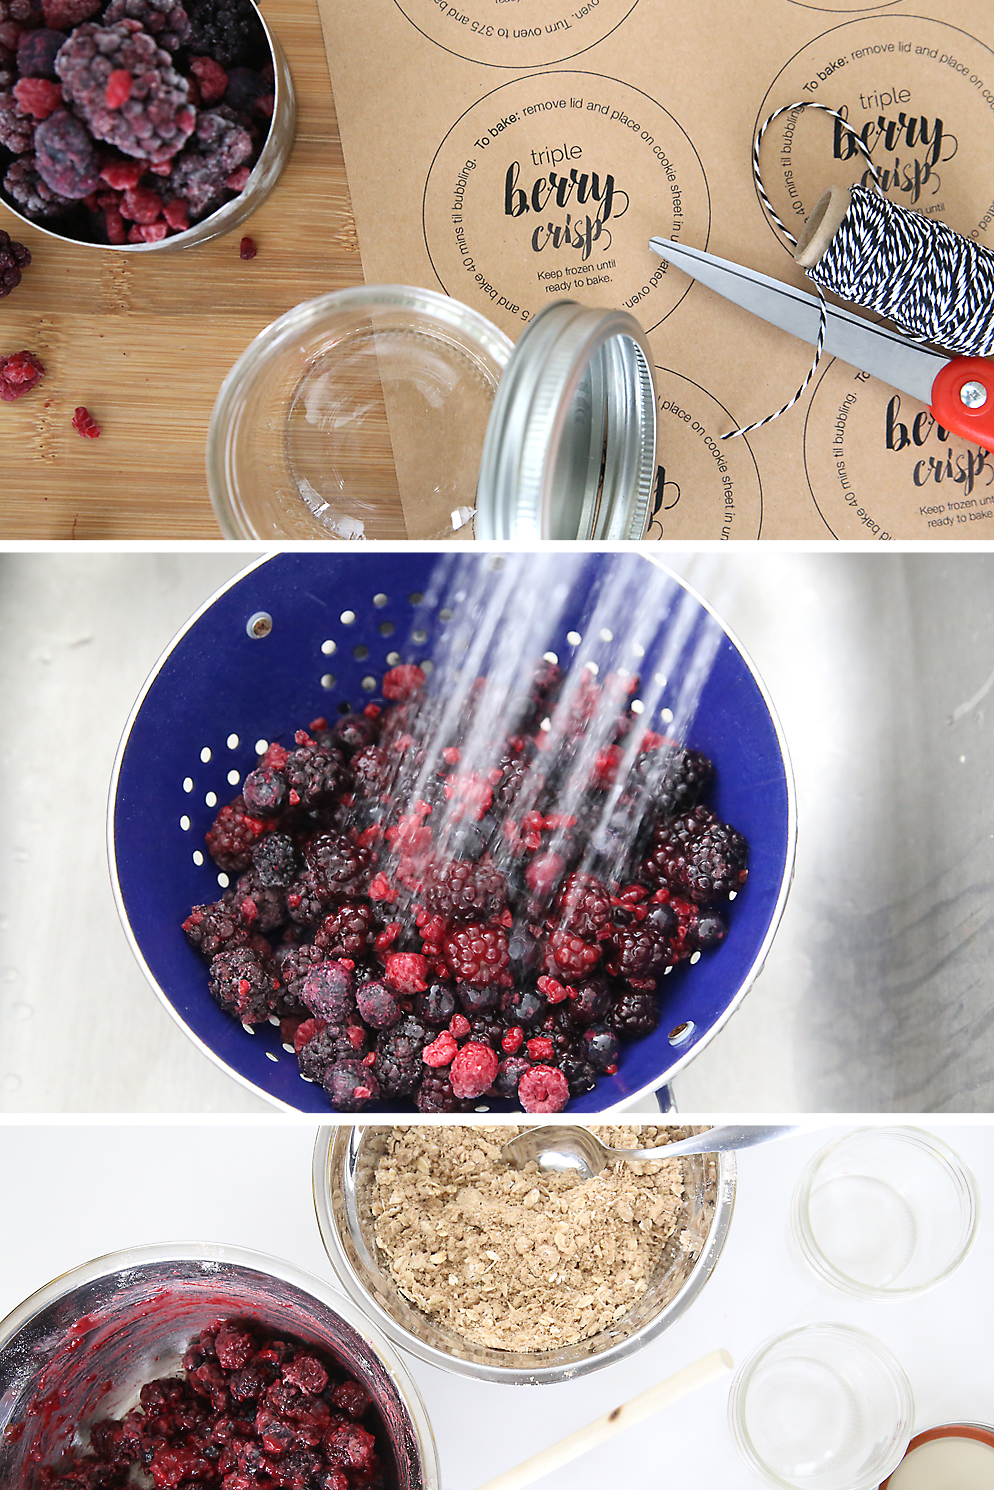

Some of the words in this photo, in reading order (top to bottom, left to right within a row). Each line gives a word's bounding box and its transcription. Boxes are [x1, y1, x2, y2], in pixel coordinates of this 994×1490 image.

[446, 7, 470, 25] and
[470, 21, 494, 37] 375
[498, 28, 509, 38] to
[513, 28, 542, 38] oven
[545, 19, 572, 34] Turn
[803, 80, 819, 94] To
[815, 55, 849, 81] bake:
[851, 42, 895, 60] remove
[898, 41, 912, 53] lid
[915, 45, 938, 58] and
[939, 52, 970, 76] place
[969, 74, 984, 89] on
[523, 98, 566, 117] remove
[569, 97, 583, 109] lid
[586, 100, 610, 115] and
[859, 87, 911, 111] triple
[487, 113, 521, 138] bake:
[610, 108, 641, 132] place
[474, 136, 490, 150] To
[640, 130, 655, 146] on
[833, 105, 958, 168] berry
[530, 143, 583, 167] triple
[652, 145, 676, 182] cookie
[781, 156, 792, 167] til
[451, 158, 477, 211] bubbling.
[504, 161, 630, 223] berry
[784, 170, 800, 197] mins
[670, 184, 684, 219] sheet
[792, 200, 805, 215] 40
[925, 202, 946, 214] until
[451, 214, 463, 224] til
[672, 220, 684, 231] in
[454, 227, 469, 255] mins
[531, 213, 612, 262] crisp
[462, 257, 476, 273] 40
[537, 268, 563, 280] Keep
[565, 262, 595, 276] frozen
[596, 259, 617, 270] until
[474, 273, 498, 301] bake
[545, 280, 571, 293] ready
[573, 279, 584, 288] to
[586, 273, 613, 285] bake.
[499, 296, 520, 314] and
[622, 285, 651, 310] oven.
[660, 399, 692, 423] place
[833, 392, 857, 444] bubbling.
[691, 421, 706, 436] on
[703, 436, 728, 473] cookie
[833, 447, 844, 458] til
[836, 461, 851, 490] mins
[912, 447, 994, 497] crisp
[721, 476, 735, 509] sheet
[844, 492, 858, 507] 40
[919, 504, 945, 515] Keep
[947, 499, 978, 511] frozen
[724, 512, 736, 523] in
[857, 507, 881, 535] bake
[928, 516, 954, 528] ready
[956, 514, 967, 523] to
